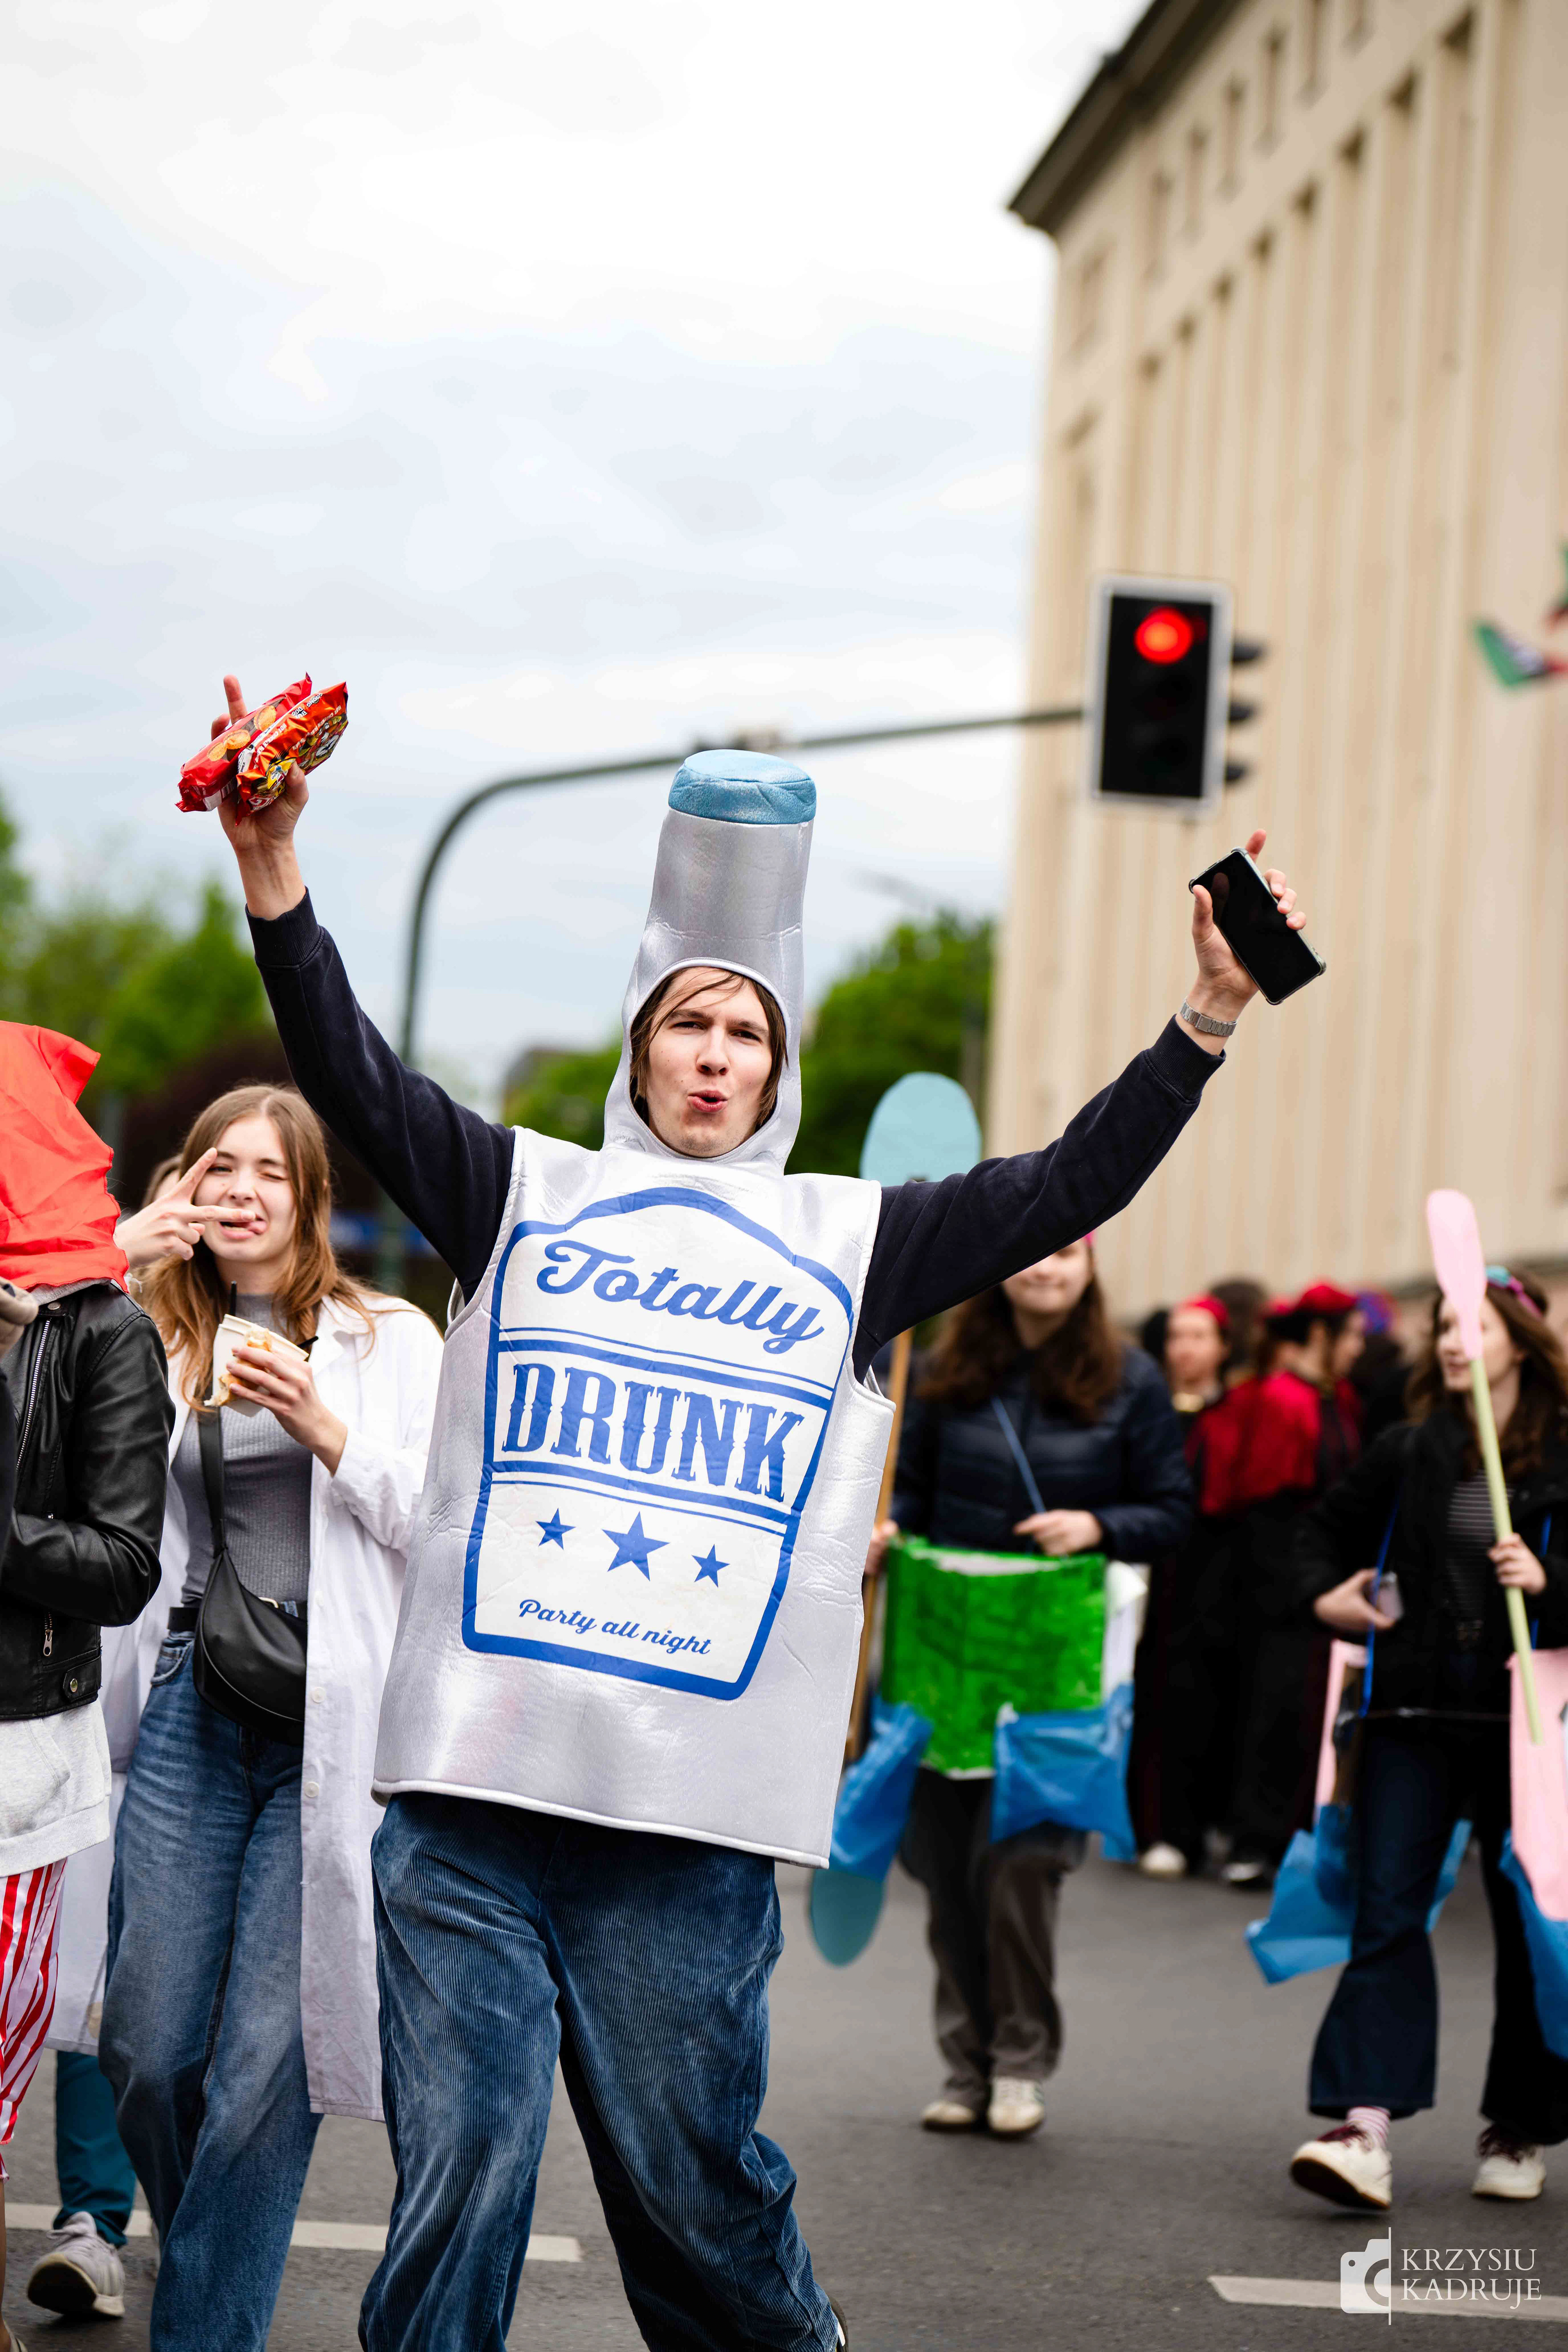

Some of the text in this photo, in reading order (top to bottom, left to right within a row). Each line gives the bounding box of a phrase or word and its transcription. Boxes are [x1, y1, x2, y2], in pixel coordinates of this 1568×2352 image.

[278, 723, 287, 733] HOT
[537, 1240, 824, 1354] Totally
[501, 1363, 804, 1503] DRUNK
[519, 1599, 711, 1655] Party all night
